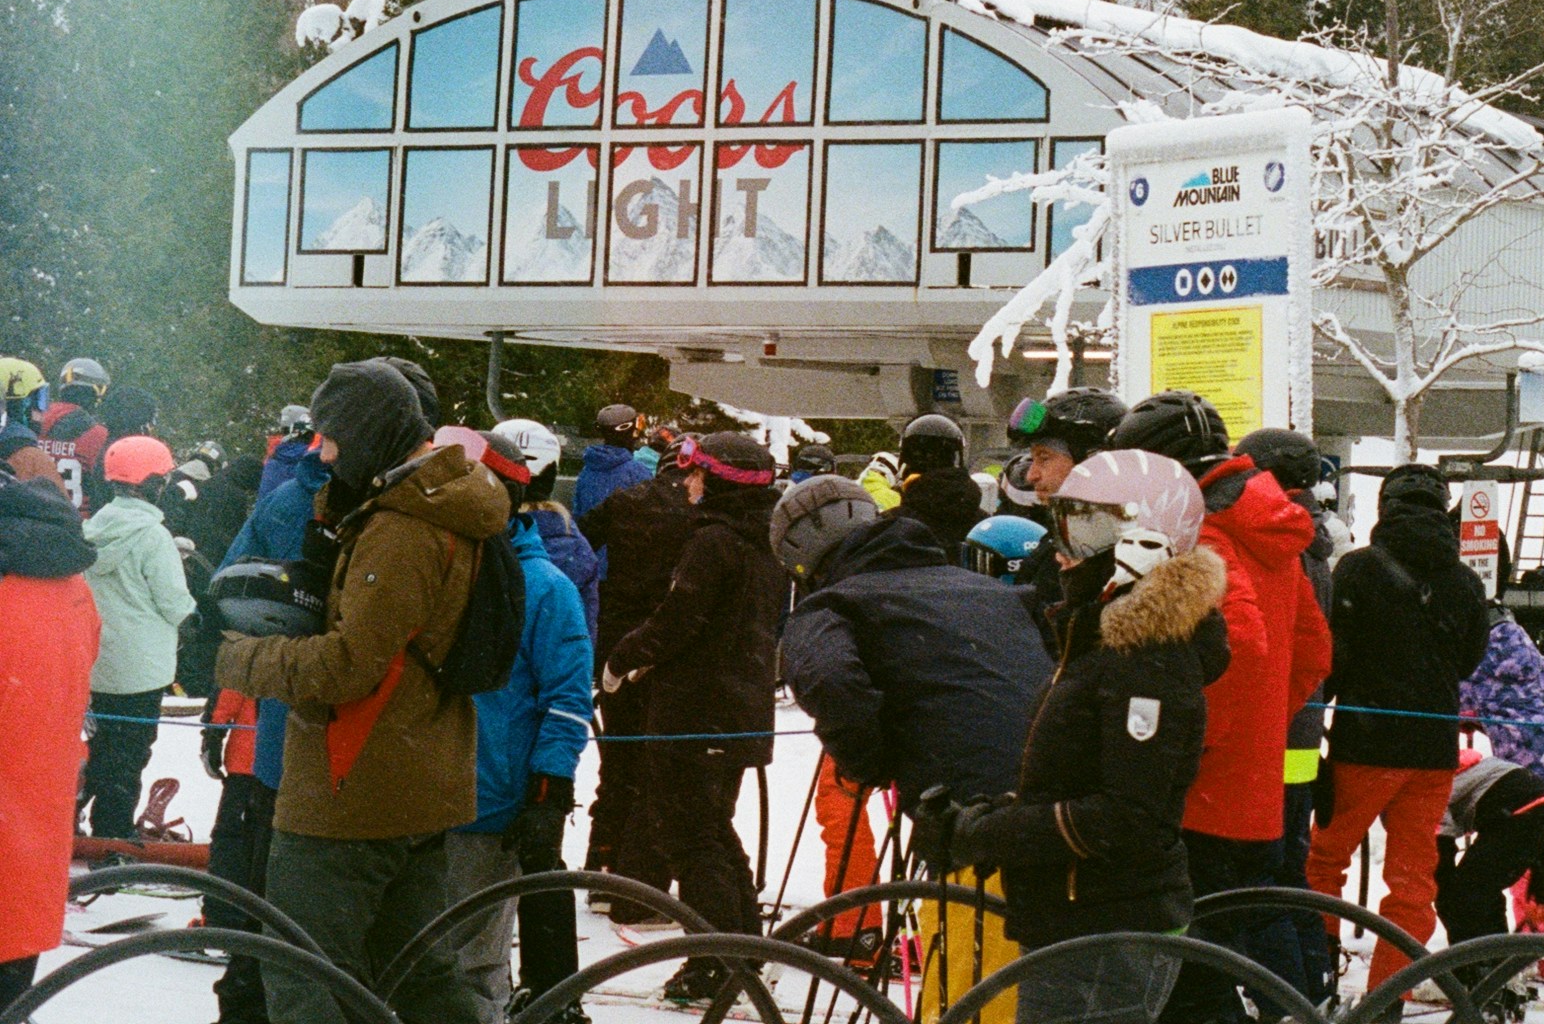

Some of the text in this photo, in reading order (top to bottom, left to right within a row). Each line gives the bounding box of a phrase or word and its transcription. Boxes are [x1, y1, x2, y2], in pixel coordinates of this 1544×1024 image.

[517, 47, 805, 171] Coors
[1212, 166, 1239, 184] BLUE
[1173, 185, 1240, 207] MOUNTAIN
[545, 178, 772, 240] LIGHT
[1150, 215, 1264, 244] SILVER BULLET
[37, 440, 76, 456] SEIDER
[1474, 525, 1485, 536] NO
[1460, 539, 1498, 552] SMOKING
